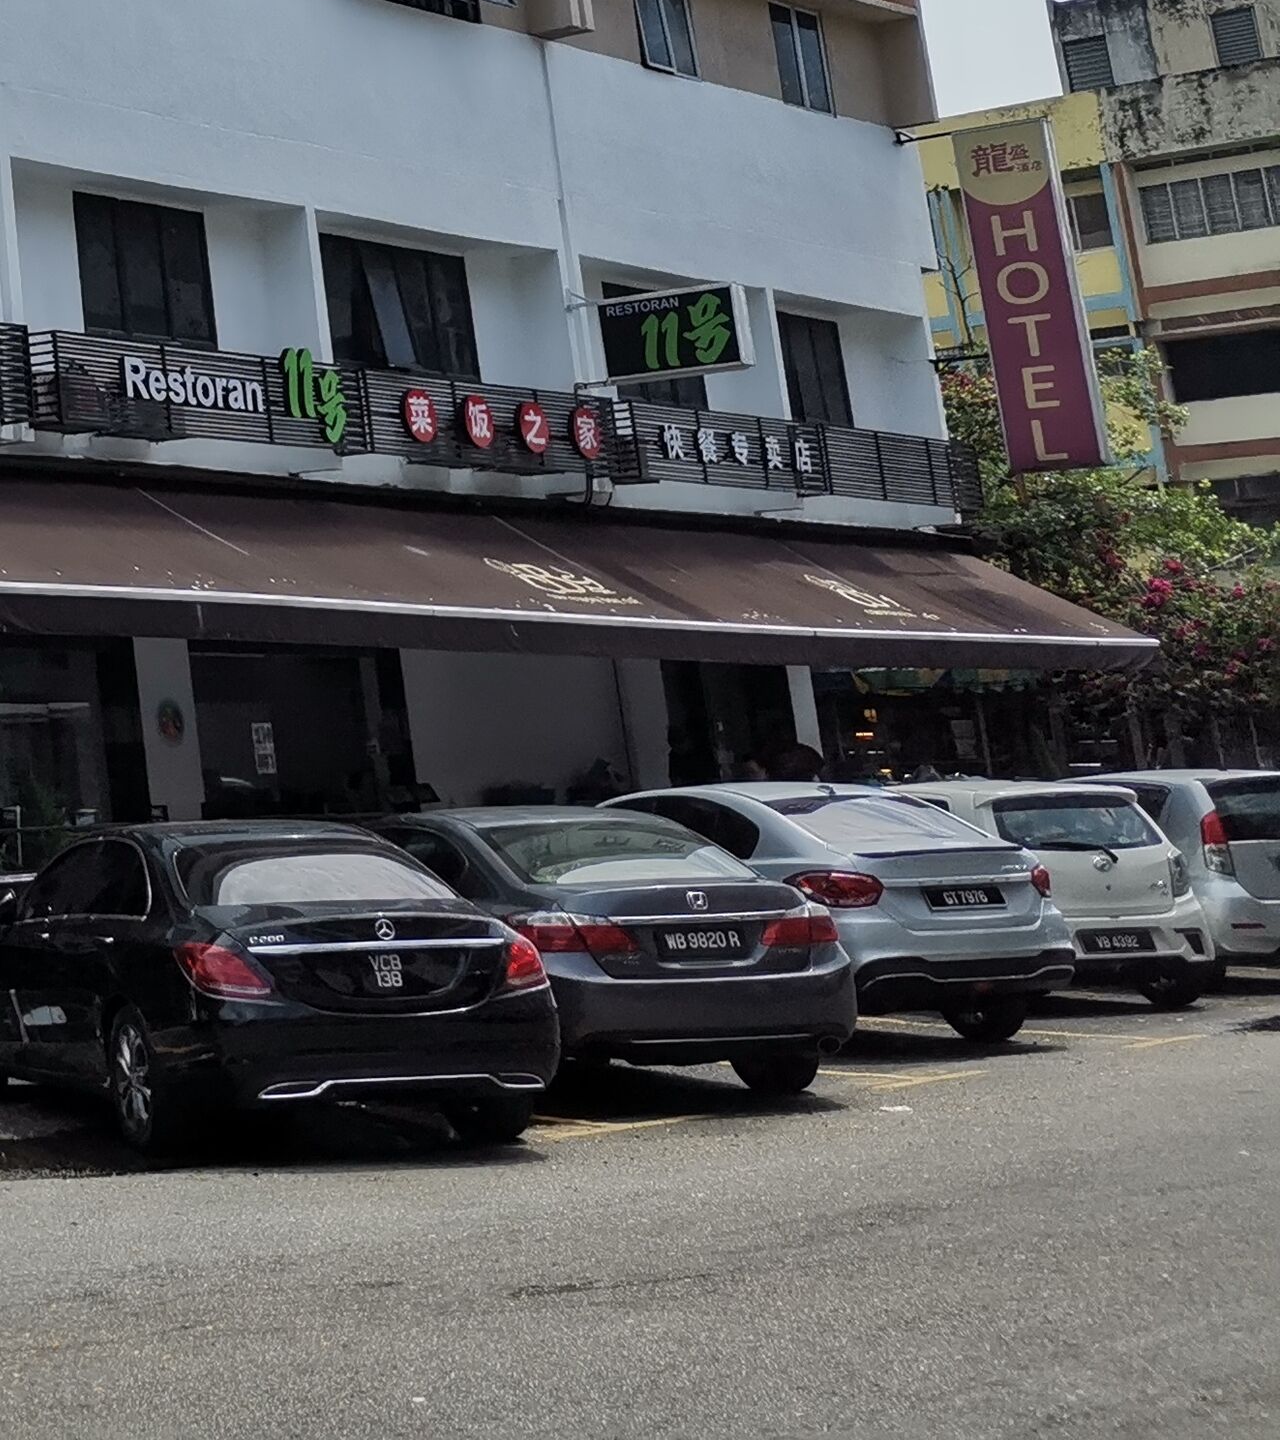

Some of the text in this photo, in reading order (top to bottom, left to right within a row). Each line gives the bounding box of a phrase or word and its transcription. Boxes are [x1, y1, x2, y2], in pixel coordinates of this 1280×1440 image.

[606, 296, 680, 317] RESTORAN
[990, 210, 1069, 461] HOTEL
[123, 355, 265, 413] Restoran
[407, 395, 599, 451] 菜饭之家
[662, 423, 813, 474] 快餐专卖店
[943, 889, 989, 905] GT 7976
[665, 931, 740, 950] WB 9820 R
[368, 954, 402, 971] VCB
[375, 971, 403, 987] 138
